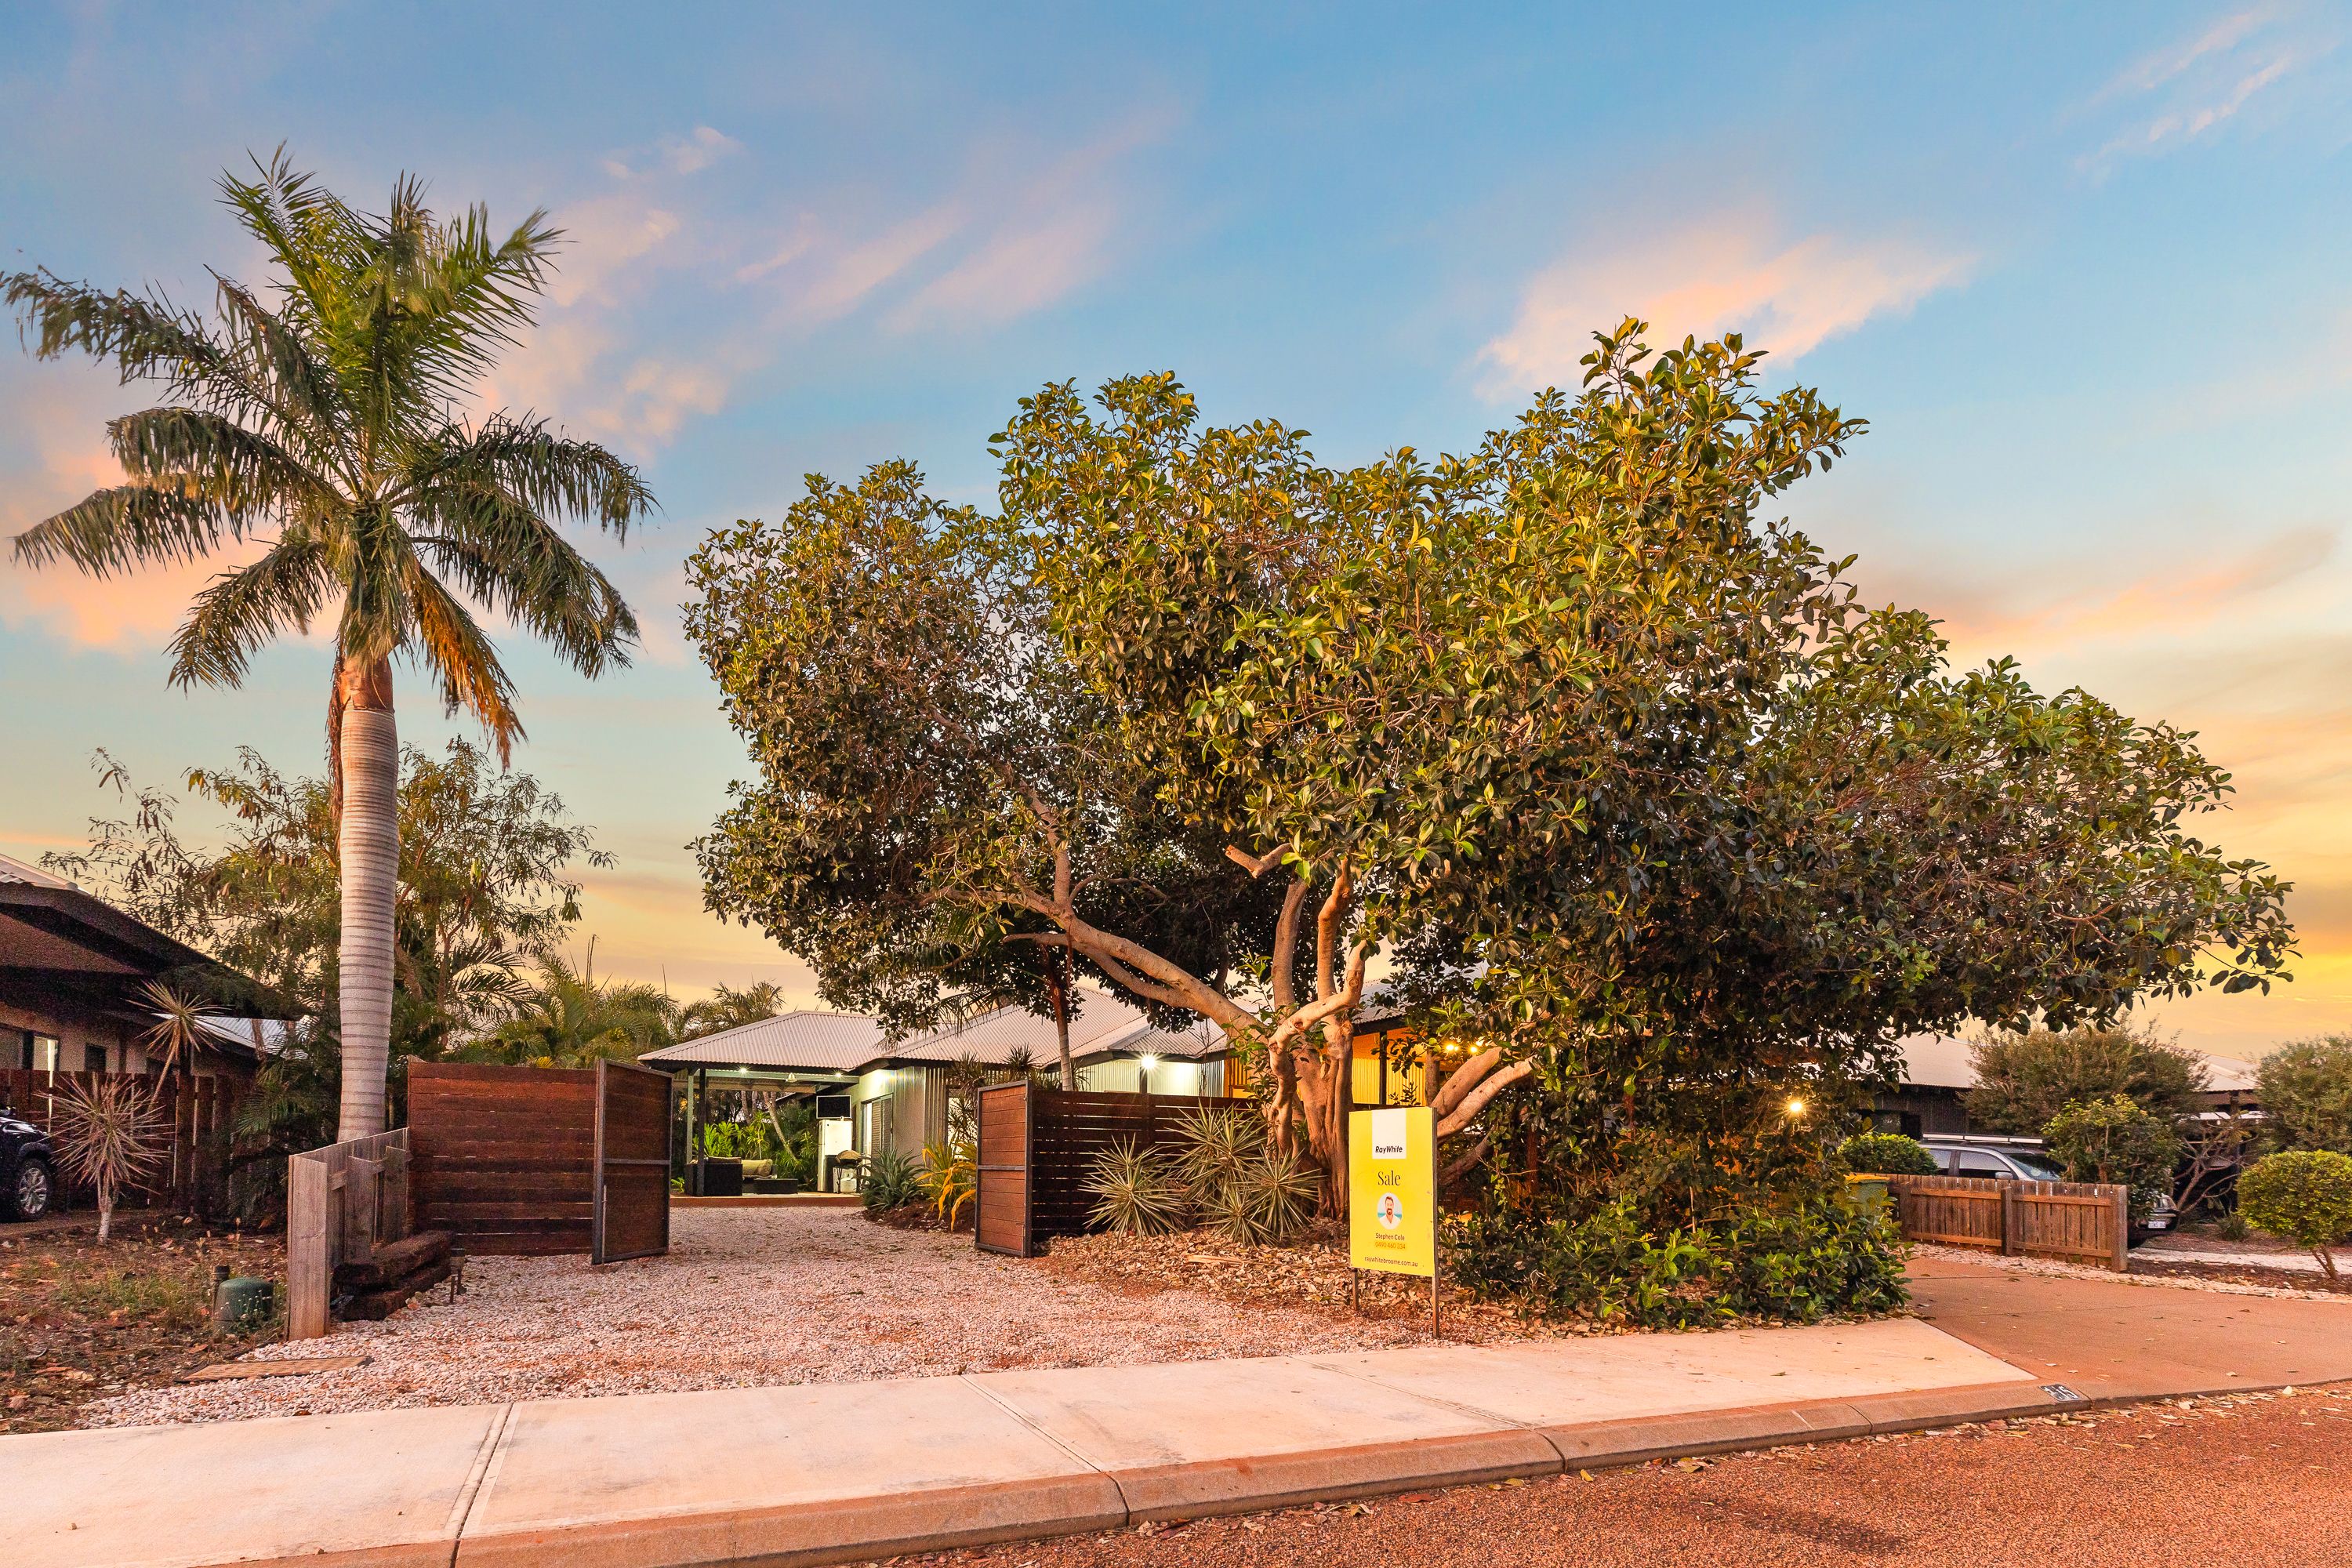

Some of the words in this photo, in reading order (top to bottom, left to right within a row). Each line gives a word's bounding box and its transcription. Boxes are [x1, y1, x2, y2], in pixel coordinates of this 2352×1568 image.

[1375, 1145, 1403, 1155] RayWhite
[1377, 1170, 1401, 1185] Sale
[1364, 1257, 1418, 1267] raywhitebroome.com.au
